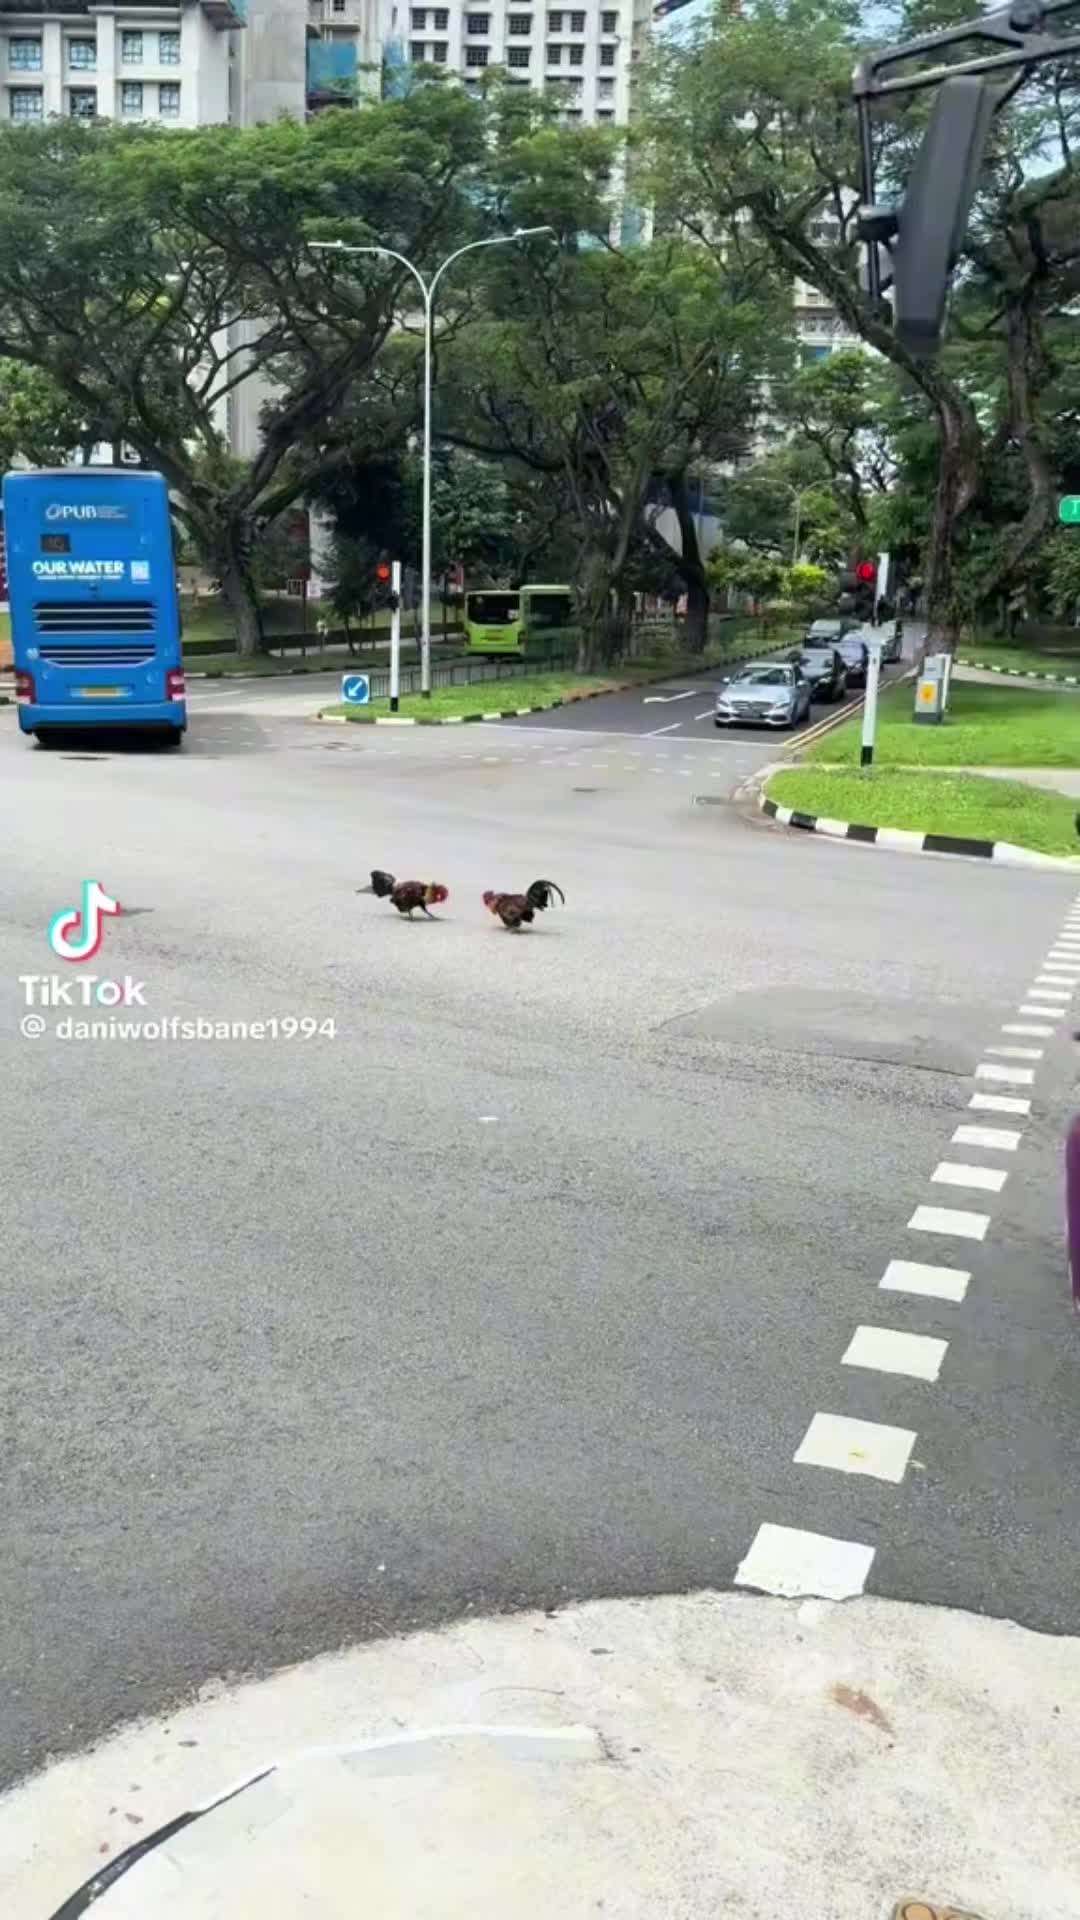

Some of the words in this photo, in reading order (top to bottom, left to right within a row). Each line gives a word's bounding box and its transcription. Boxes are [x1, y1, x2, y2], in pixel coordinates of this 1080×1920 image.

[63, 505, 97, 519] PUB
[32, 560, 67, 574] OUR
[68, 560, 125, 574] WATER
